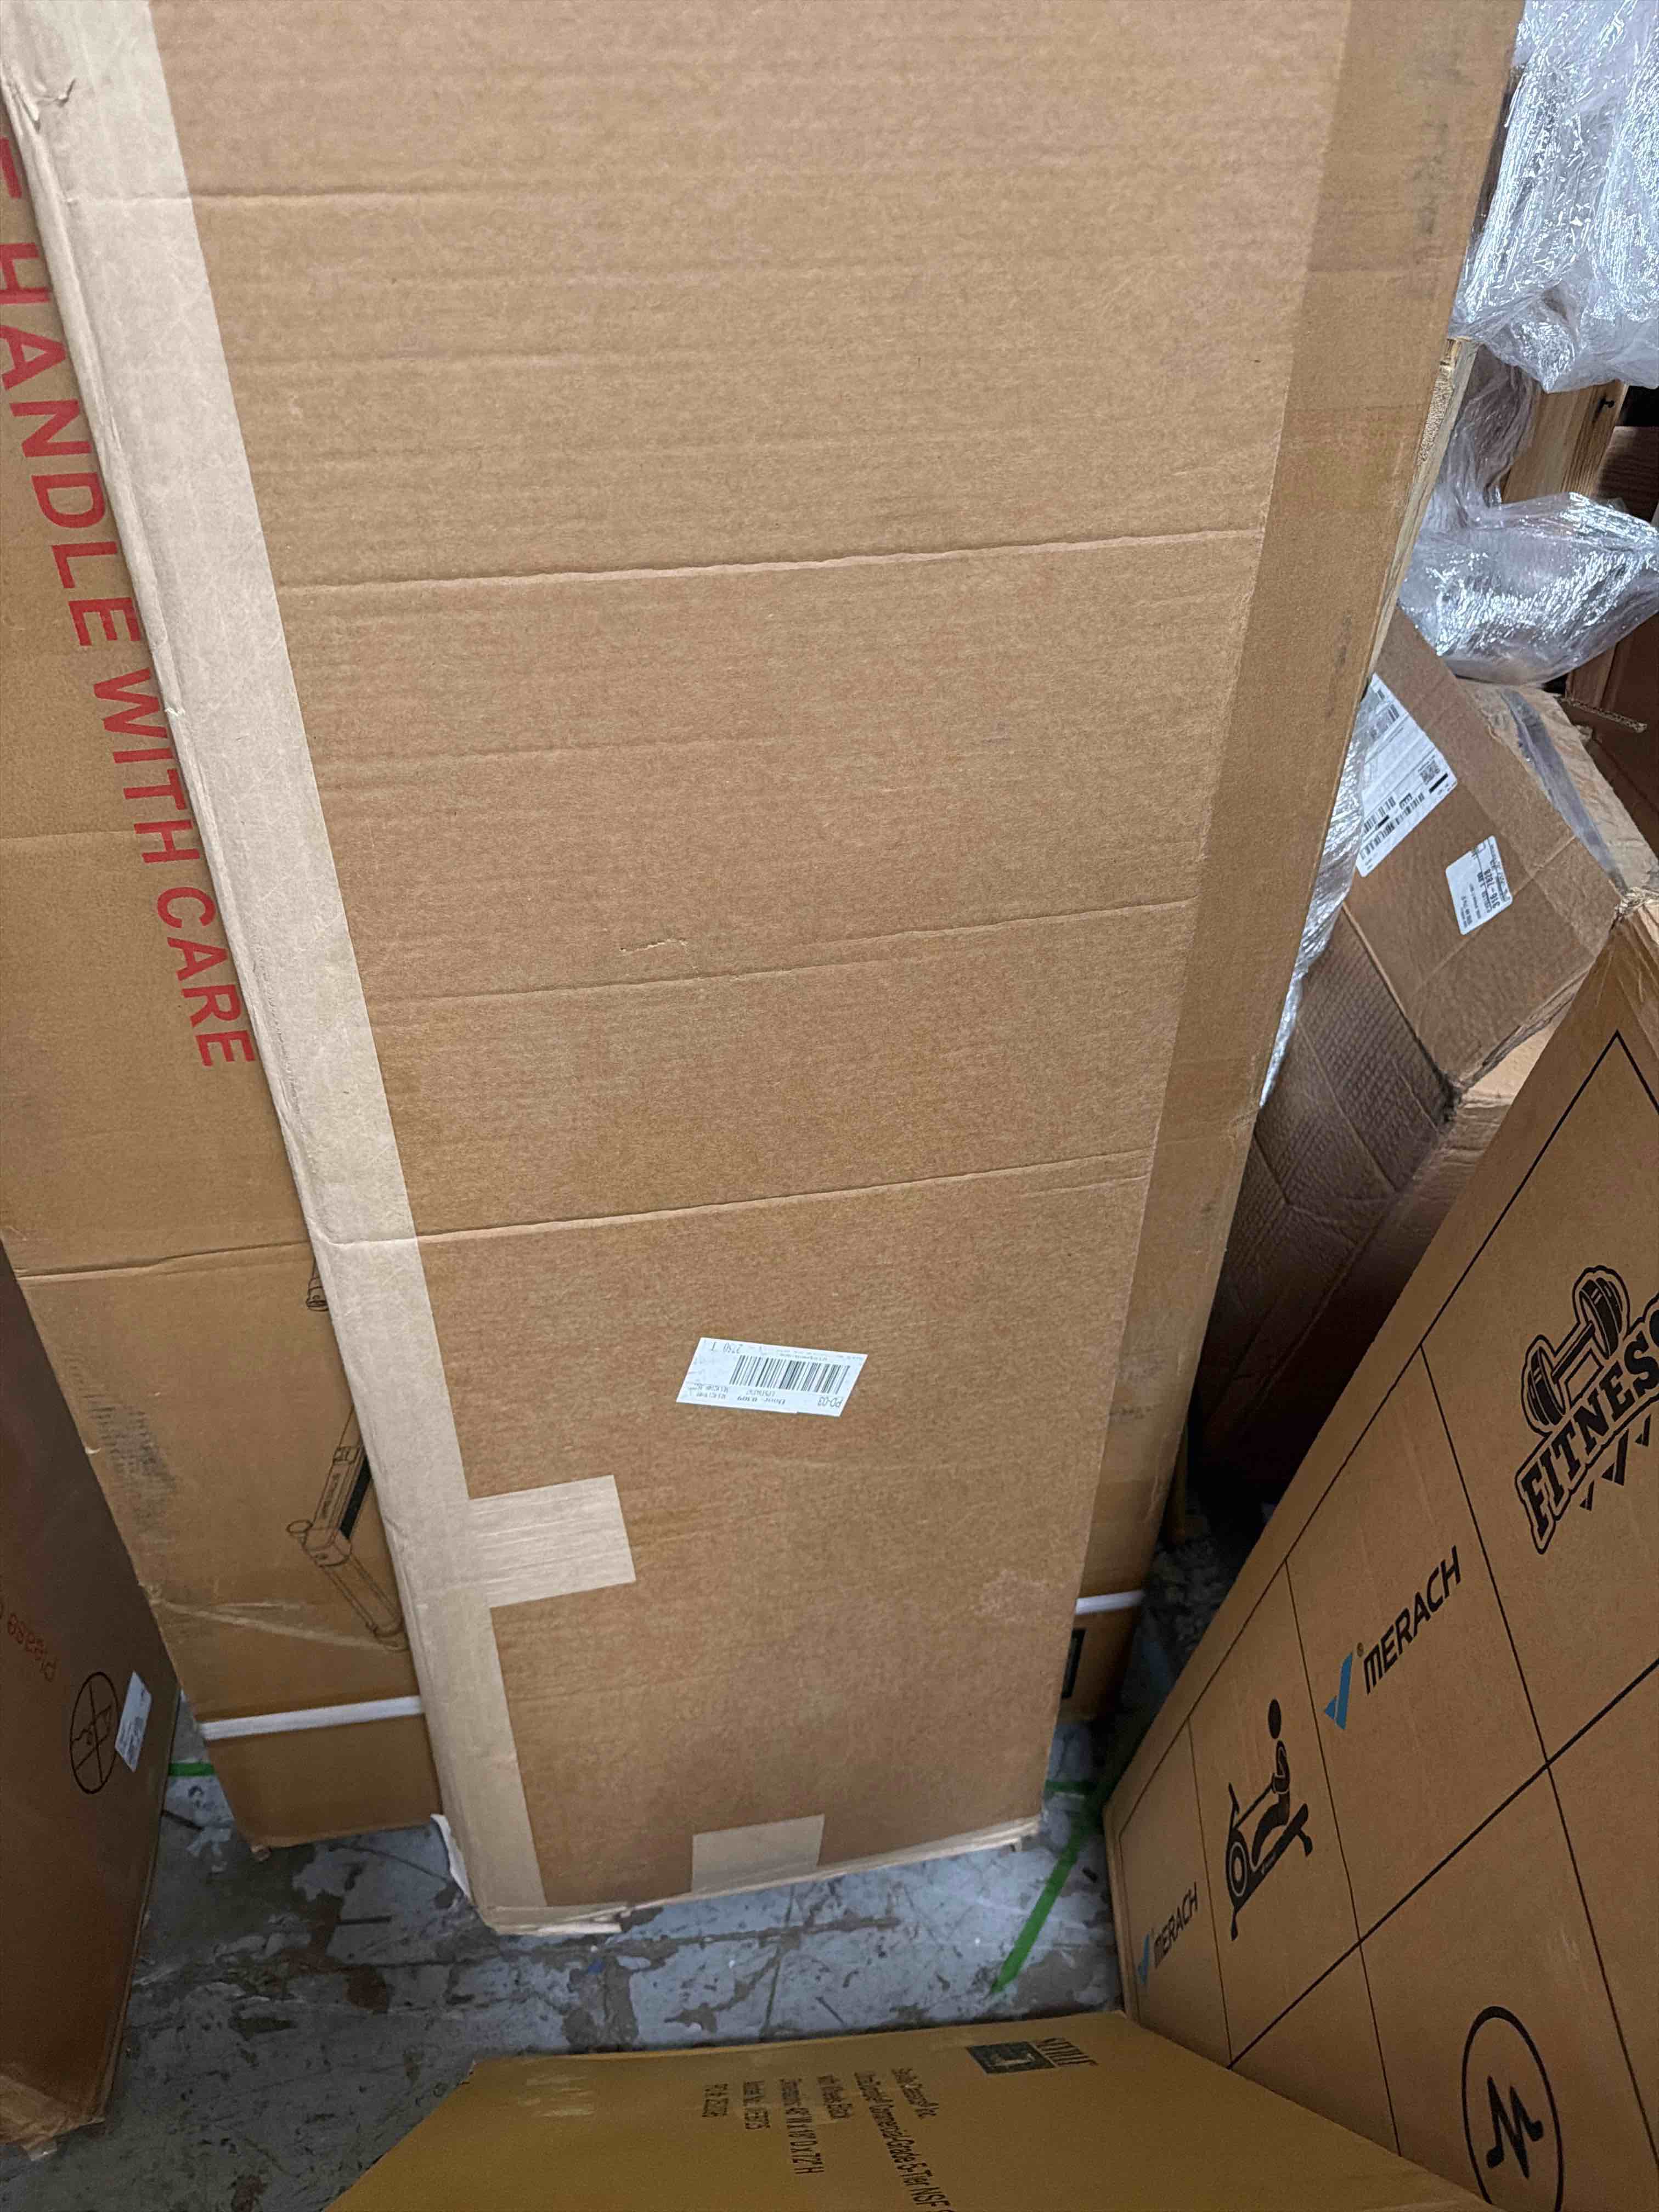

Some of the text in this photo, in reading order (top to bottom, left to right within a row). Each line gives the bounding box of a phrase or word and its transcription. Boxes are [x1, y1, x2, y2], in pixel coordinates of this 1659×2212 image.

[0, 241, 257, 1067] HANDLE WITH CARE
[1521, 1308, 1659, 1541] FITNES
[1363, 1544, 1461, 1695] MERACH
[1154, 1881, 1198, 1969] MERACH
[910, 2186, 951, 2207] NSF
